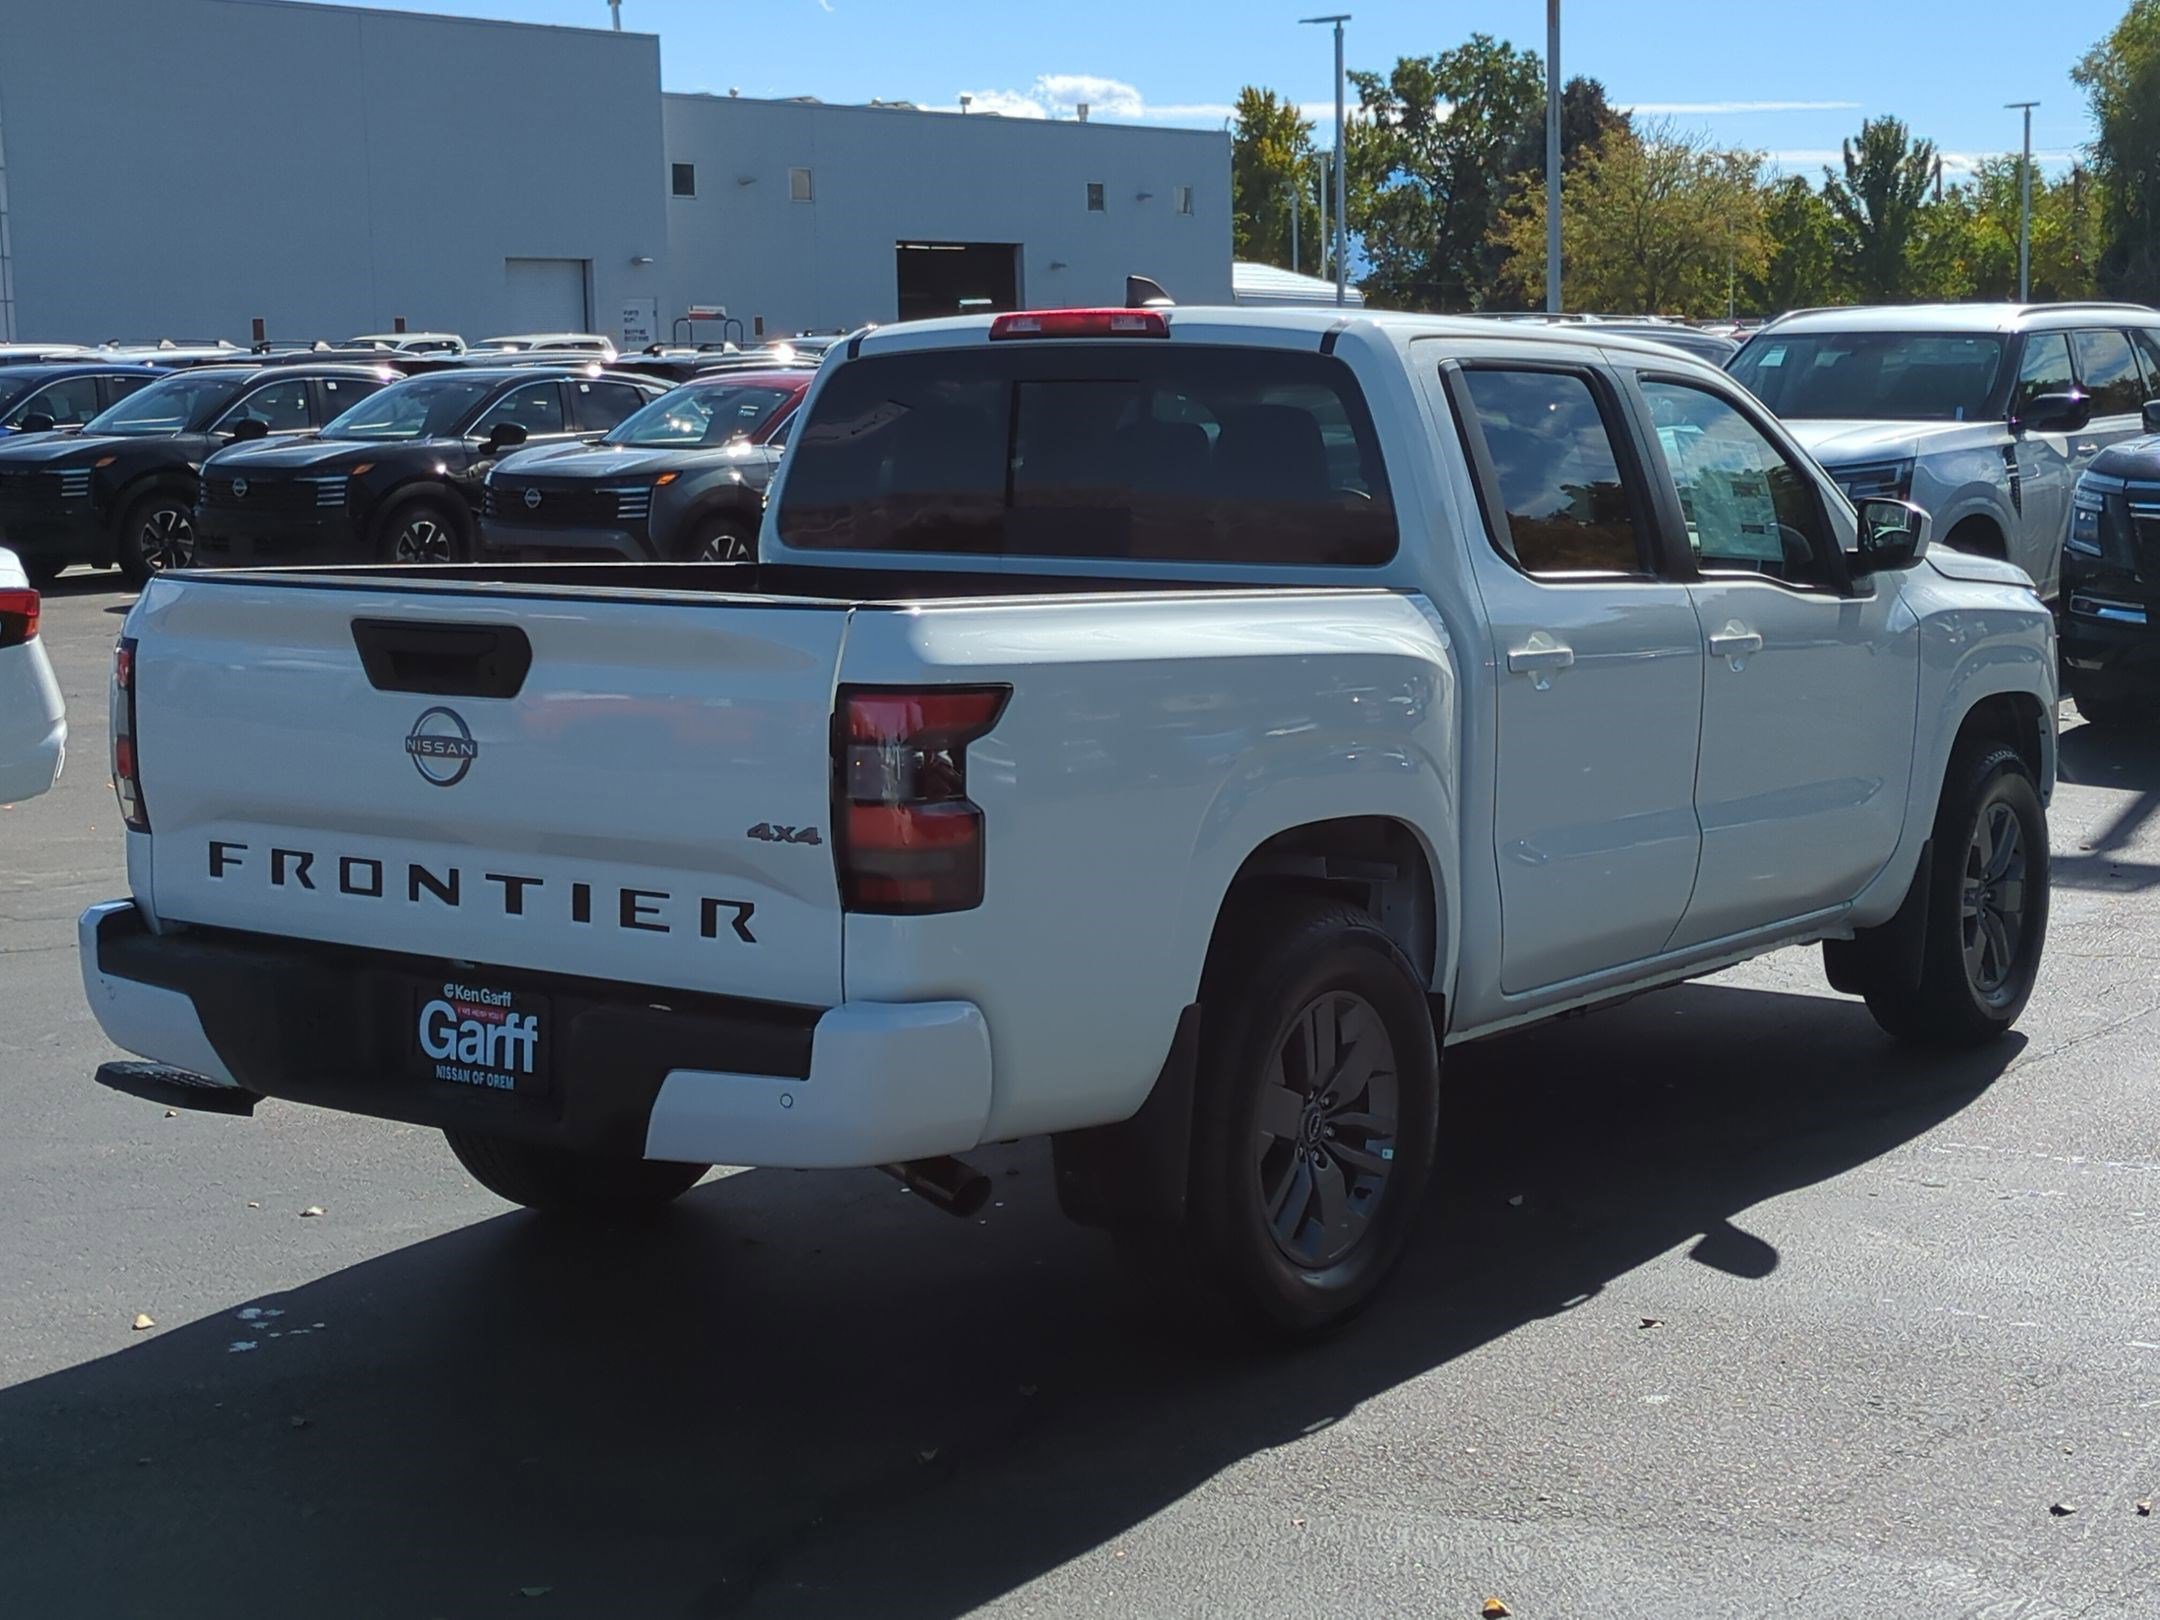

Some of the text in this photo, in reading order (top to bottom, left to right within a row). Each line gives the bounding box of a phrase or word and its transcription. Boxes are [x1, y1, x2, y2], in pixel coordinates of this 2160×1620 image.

[406, 739, 474, 756] NISSAN
[208, 841, 757, 943] FRONTIER
[455, 984, 511, 1007] Ken Garff
[419, 1000, 538, 1073] Garff
[436, 1065, 514, 1090] NISSAN OF OREM
